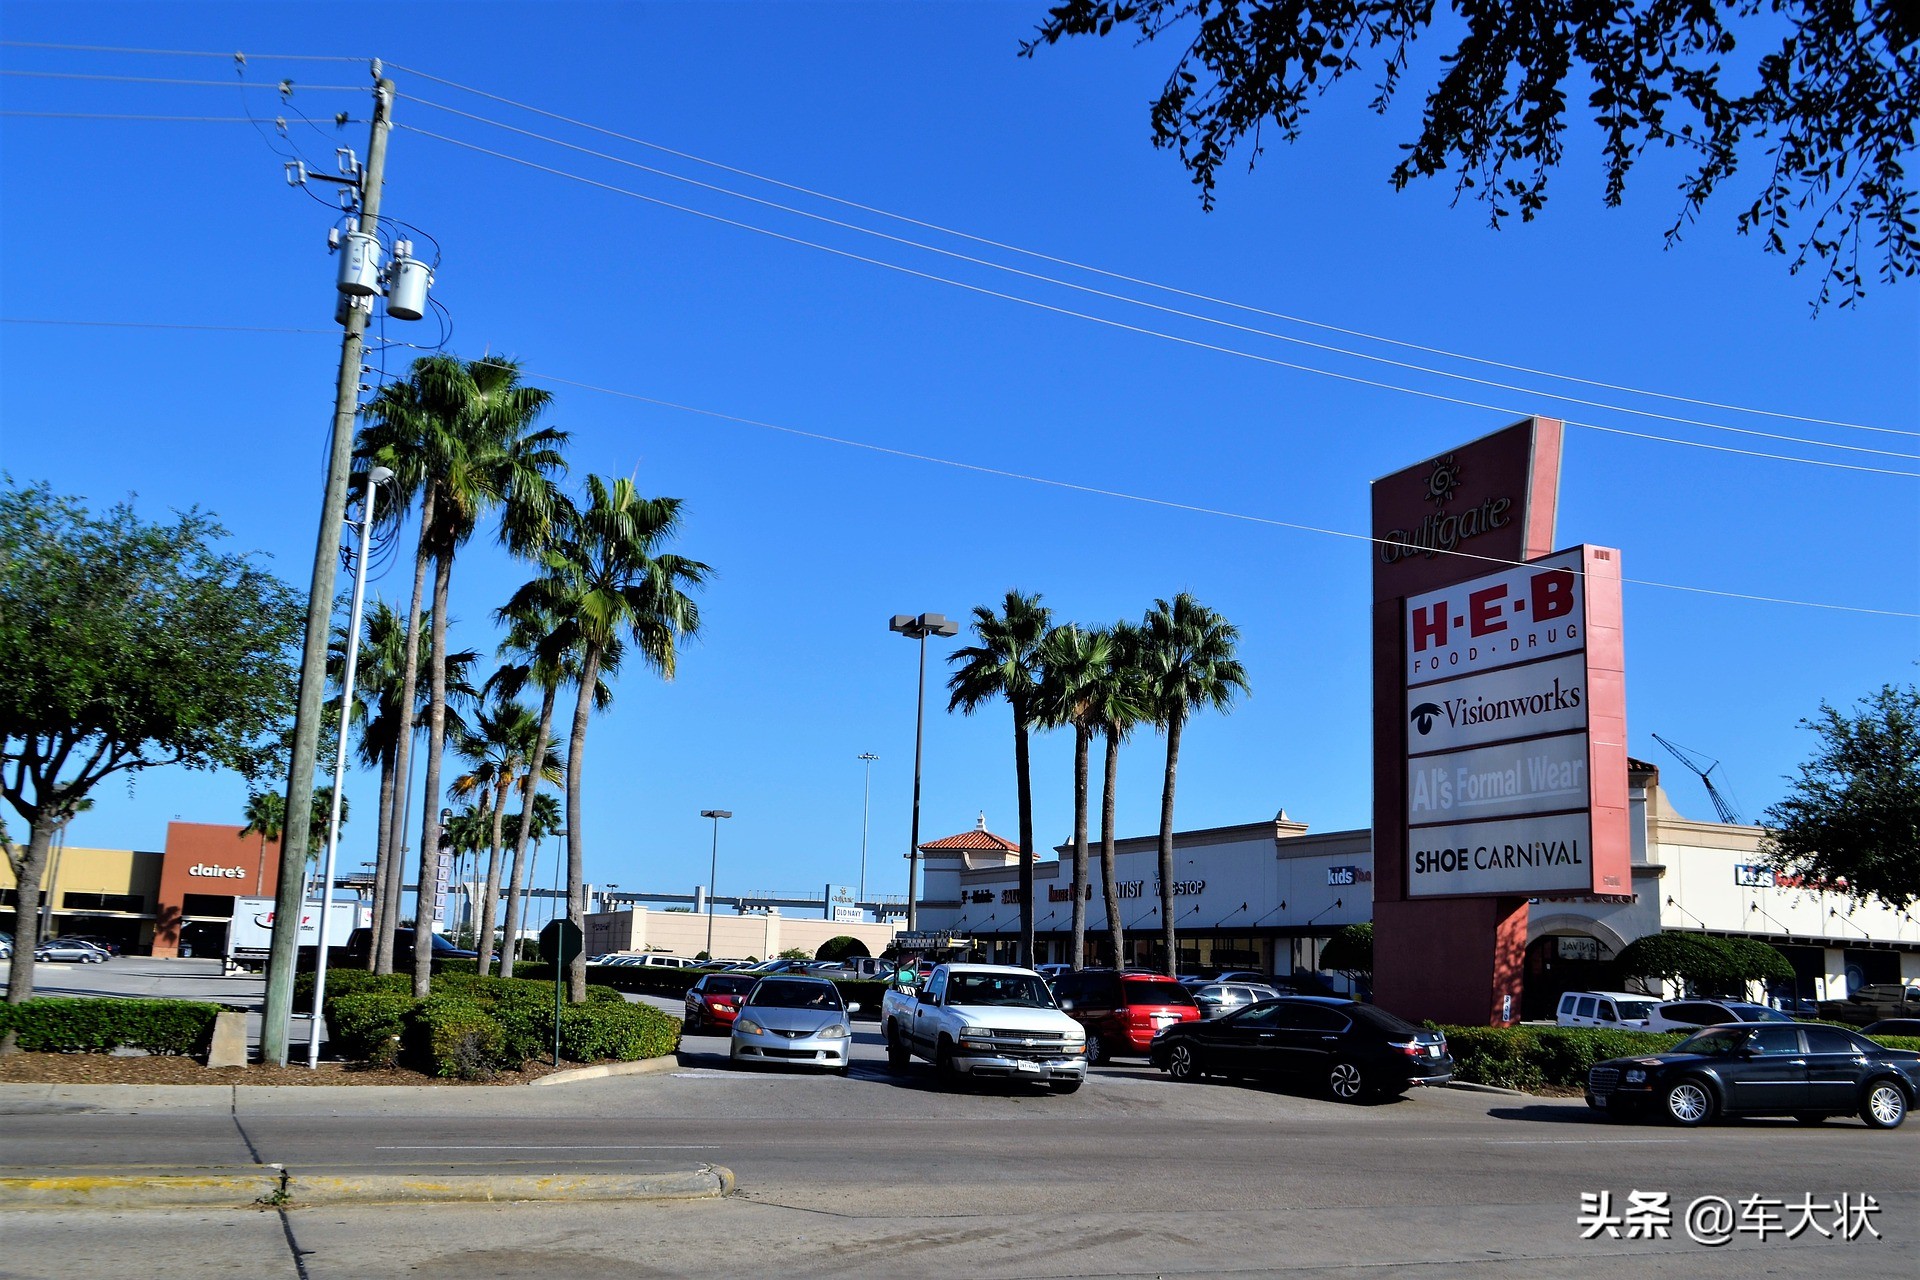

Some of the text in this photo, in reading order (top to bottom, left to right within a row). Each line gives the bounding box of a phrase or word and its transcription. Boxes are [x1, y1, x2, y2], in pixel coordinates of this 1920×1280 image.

[1380, 497, 1511, 565] Gulfgate
[1414, 624, 1577, 673] FOOD DRUG
[1443, 678, 1581, 728] Visionworks
[1412, 755, 1584, 812] Al's Formal Wear
[189, 863, 246, 878] claire's
[1328, 867, 1353, 885] kids
[1415, 848, 1469, 874] SHOE
[1102, 880, 1143, 899] NTIST
